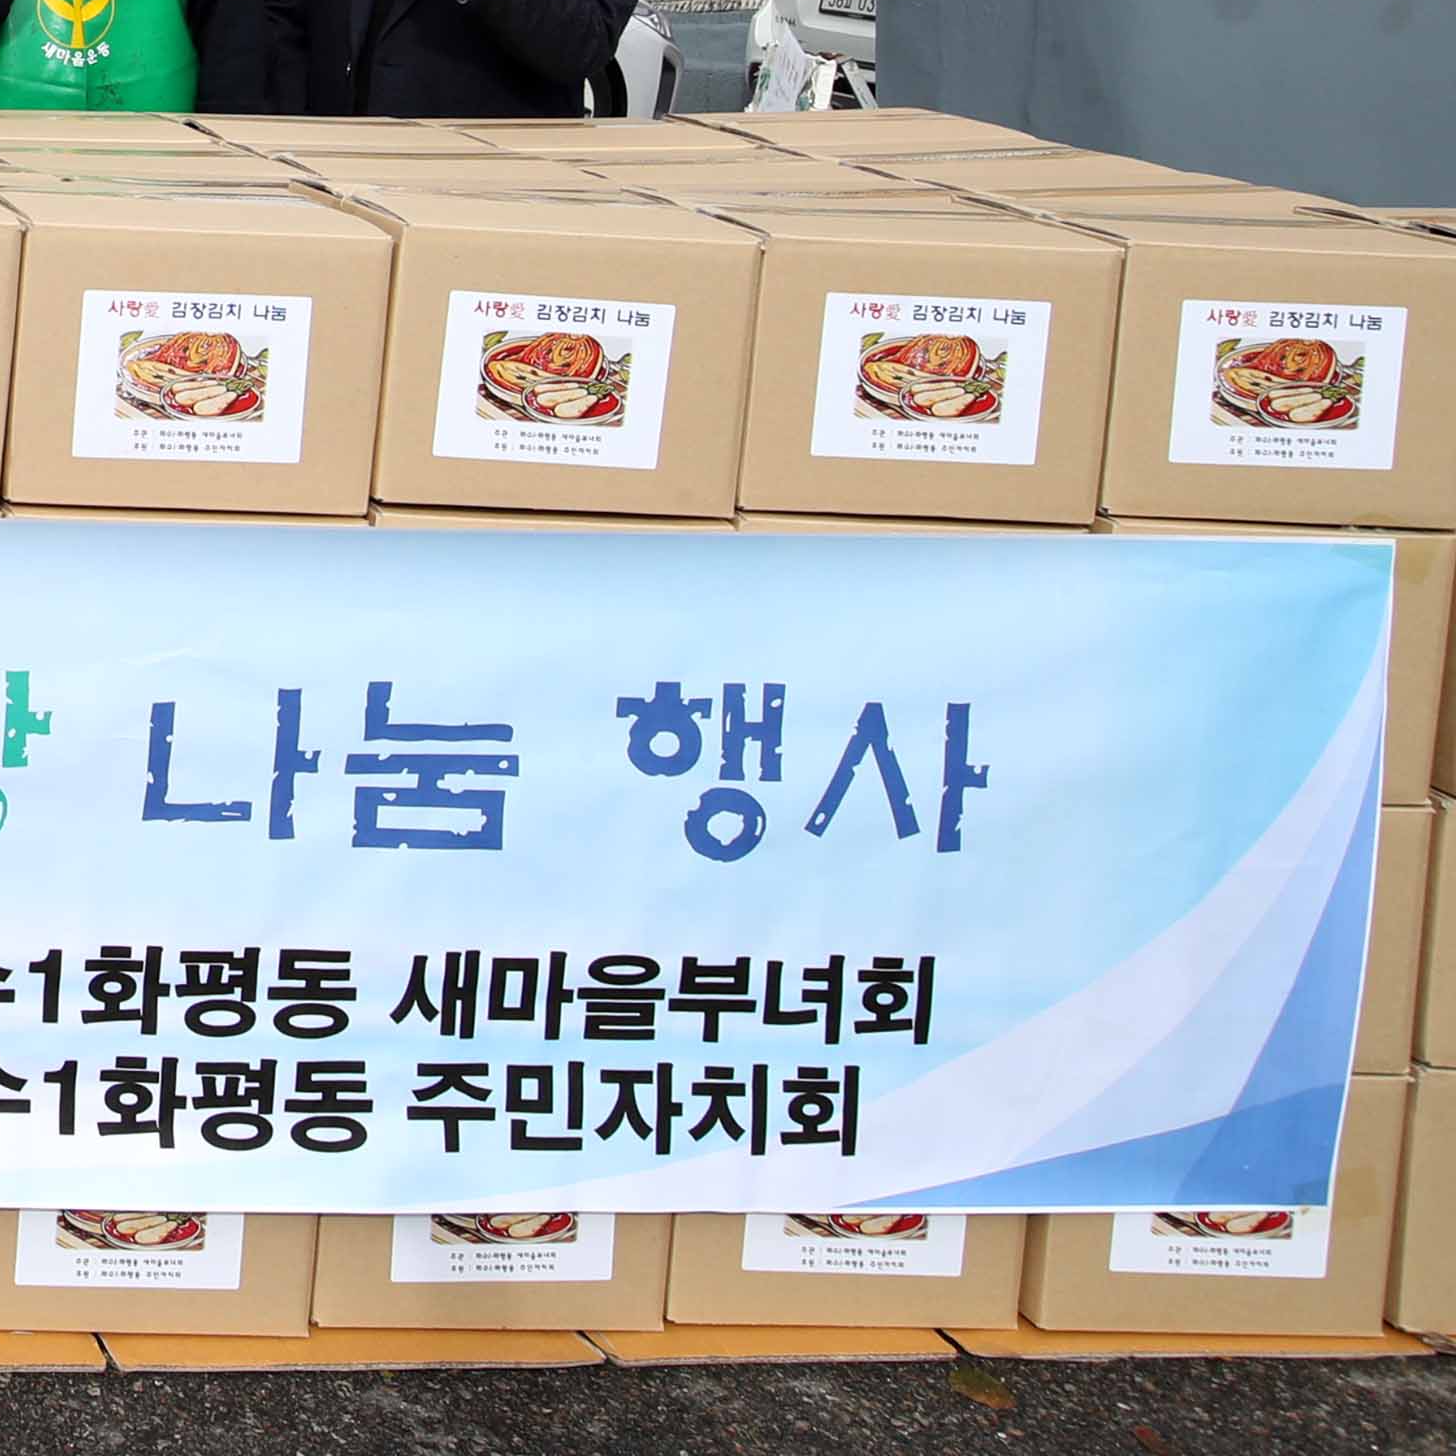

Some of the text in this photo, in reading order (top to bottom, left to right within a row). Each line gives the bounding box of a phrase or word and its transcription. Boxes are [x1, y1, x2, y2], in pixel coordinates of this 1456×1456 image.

[41, 41, 110, 67] 새마을운동
[171, 301, 242, 320] 김장김치
[253, 304, 287, 322] 나눔
[536, 303, 606, 324] 김장김치
[616, 309, 651, 328] 나눔
[912, 304, 982, 323] 김장김치
[992, 308, 1027, 326] 나눔
[1269, 311, 1339, 329] 김장김치
[1349, 314, 1383, 331] 나눔
[144, 682, 518, 849] 나눔
[617, 683, 988, 862] 행사
[390, 951, 934, 1044] 새마을부녀회
[407, 1062, 859, 1156] 주민자치회
